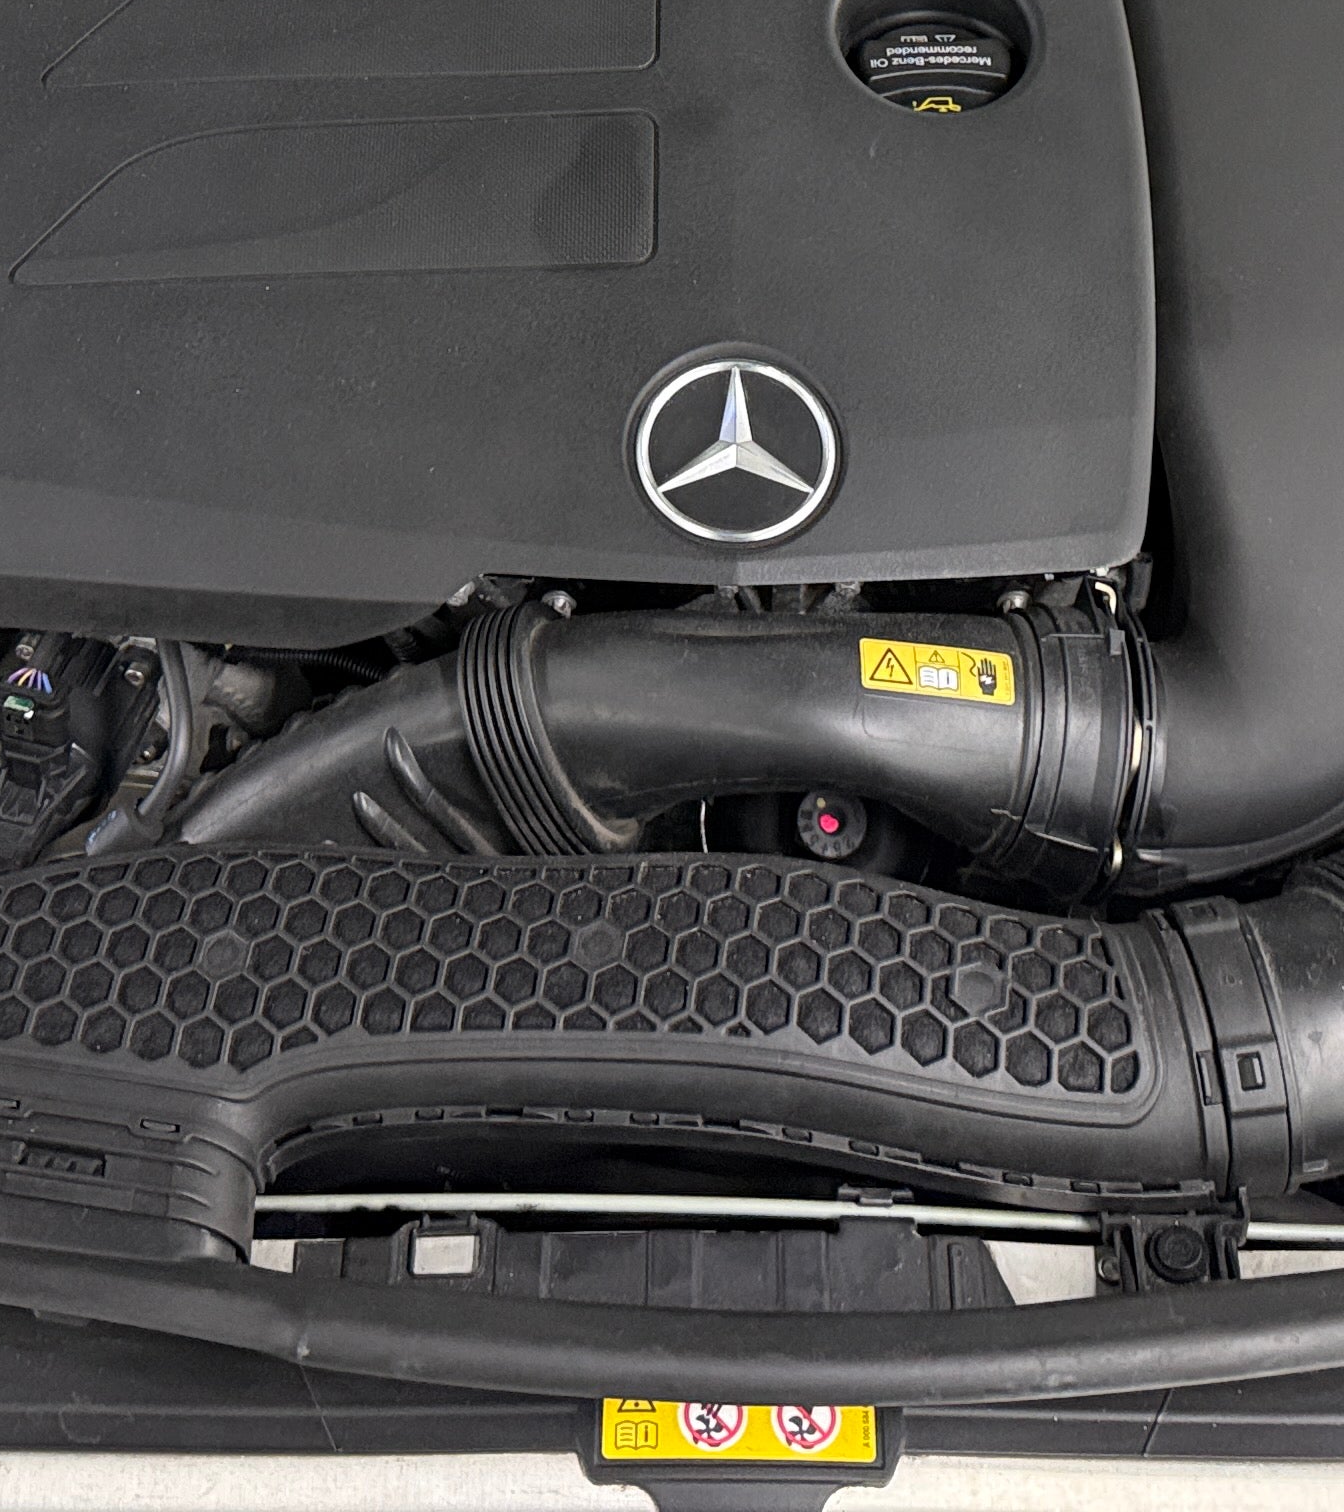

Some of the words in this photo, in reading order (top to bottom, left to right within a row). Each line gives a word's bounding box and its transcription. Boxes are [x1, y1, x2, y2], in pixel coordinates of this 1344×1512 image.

[886, 46, 977, 56] recommended
[870, 57, 889, 68] Oil
[892, 56, 992, 67] Mercedes-Benz
